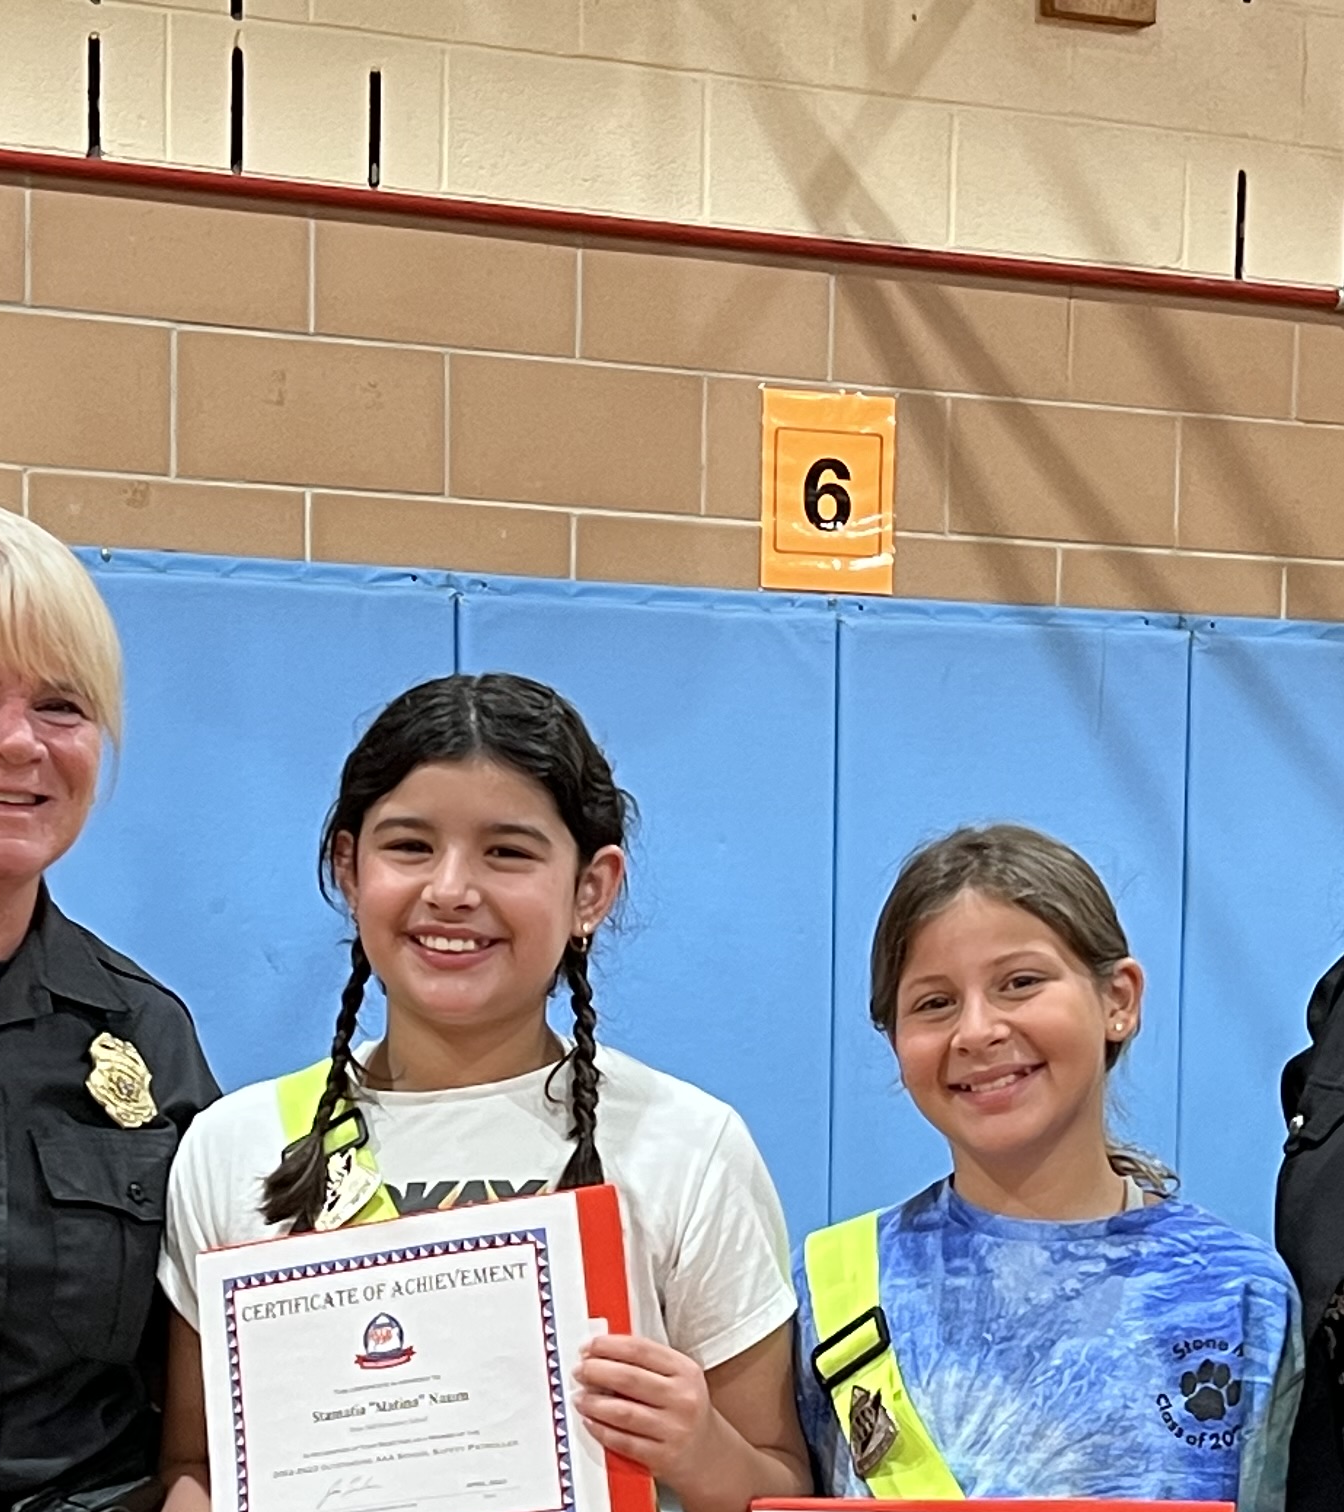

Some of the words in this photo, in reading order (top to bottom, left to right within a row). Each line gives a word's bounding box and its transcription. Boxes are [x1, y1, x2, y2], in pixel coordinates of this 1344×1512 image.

[803, 457, 851, 532] 6
[241, 1287, 358, 1323] CERTIFICATE
[363, 1282, 386, 1302] OF
[391, 1262, 528, 1298] ACHIEVEMENT
[1172, 1338, 1229, 1360] Stone
[1156, 1393, 1184, 1438] Class
[1185, 1432, 1206, 1449] of
